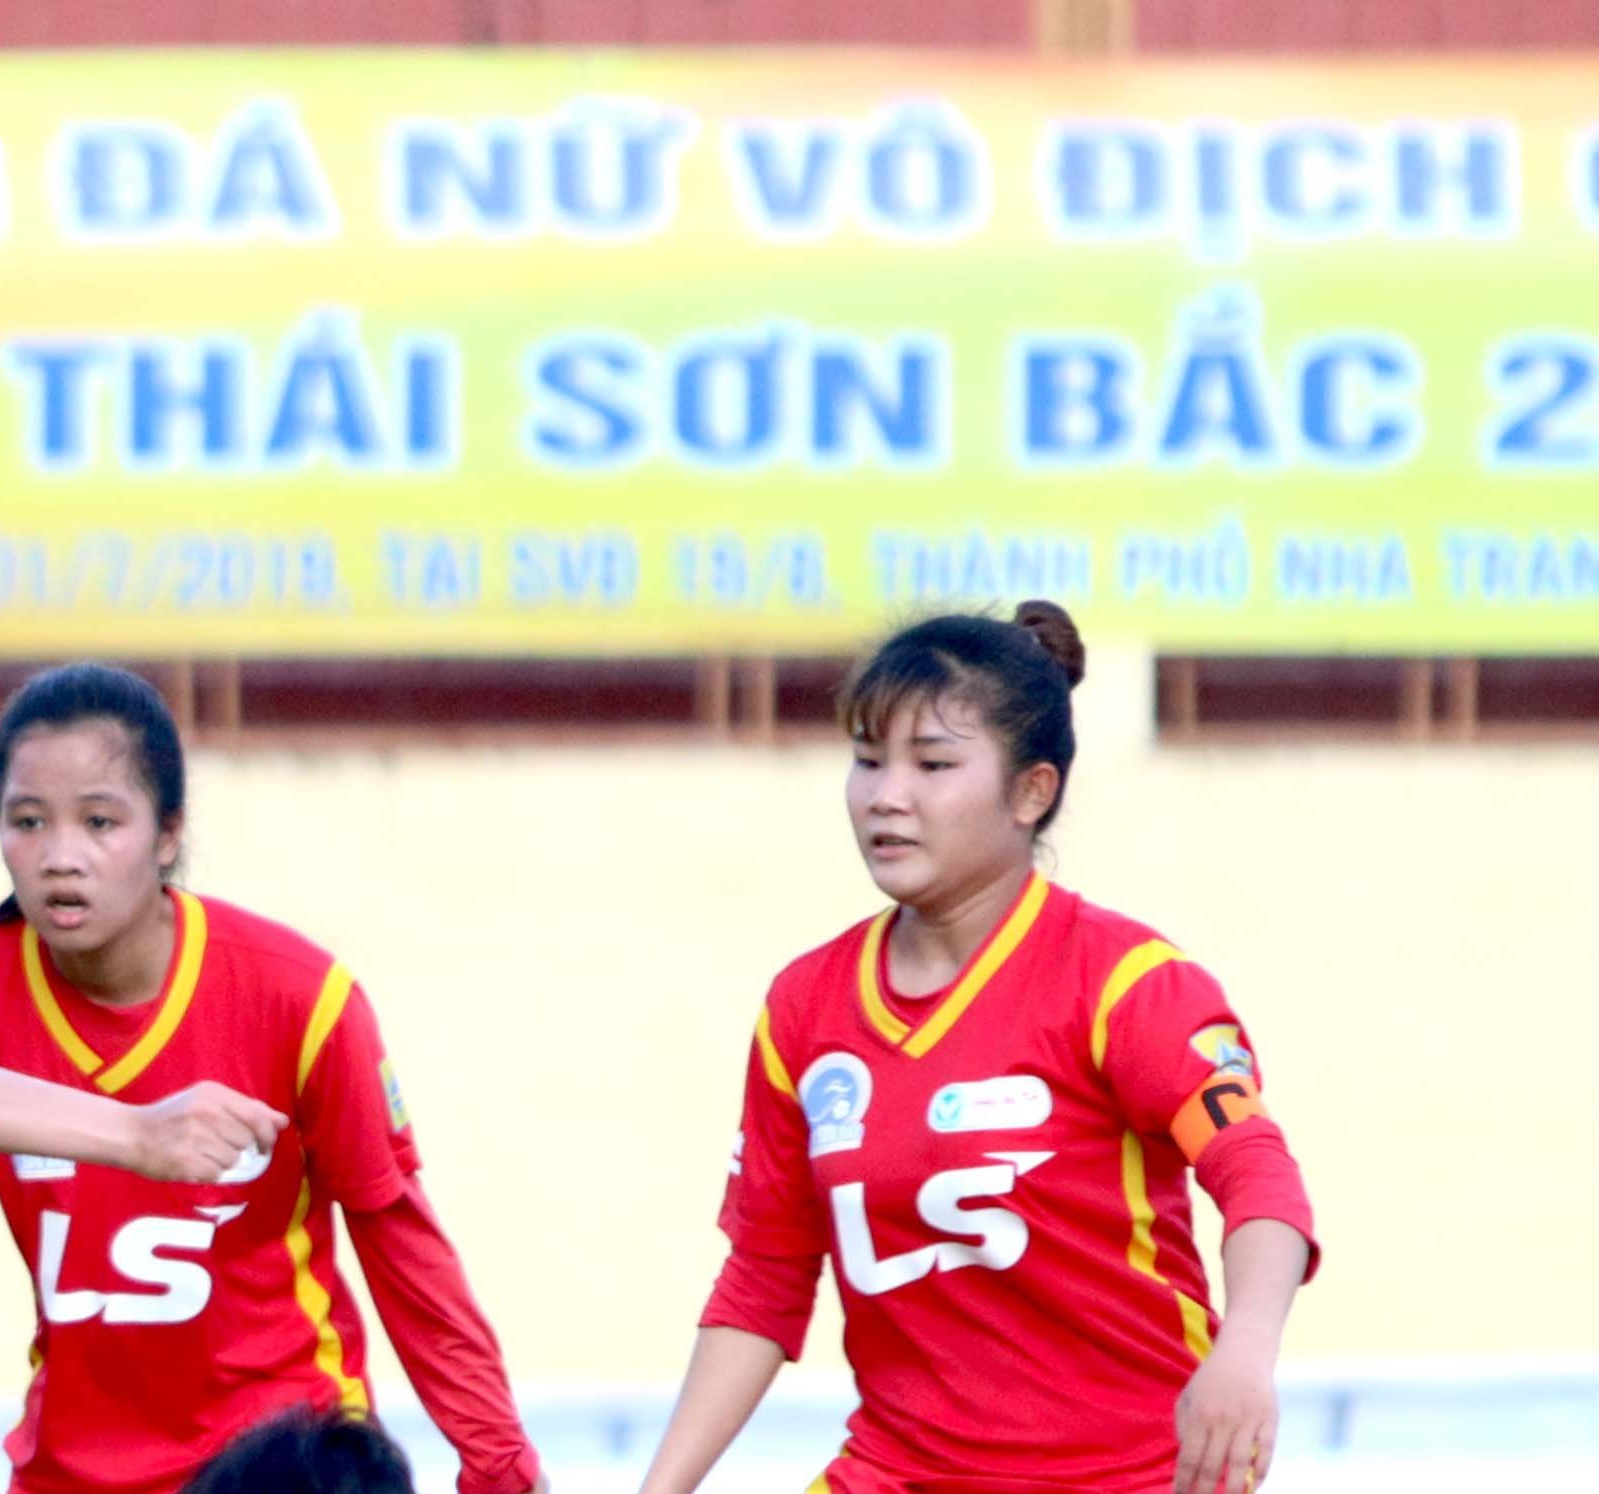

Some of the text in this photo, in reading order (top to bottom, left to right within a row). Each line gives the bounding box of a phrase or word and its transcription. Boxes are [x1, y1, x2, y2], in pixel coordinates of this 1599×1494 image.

[69, 102, 325, 230] ĐÁ
[404, 104, 681, 230] NỮ
[739, 106, 977, 230] VÔ
[1053, 126, 1505, 254] ĐỊCH
[14, 314, 447, 460] THÁI
[534, 330, 935, 462] SƠN
[1022, 292, 1409, 462] BẮC
[871, 530, 1091, 600] THÀNH
[1276, 535, 1413, 600] NHA
[37, 1204, 247, 1324] LS
[829, 1152, 1055, 1295] LS
